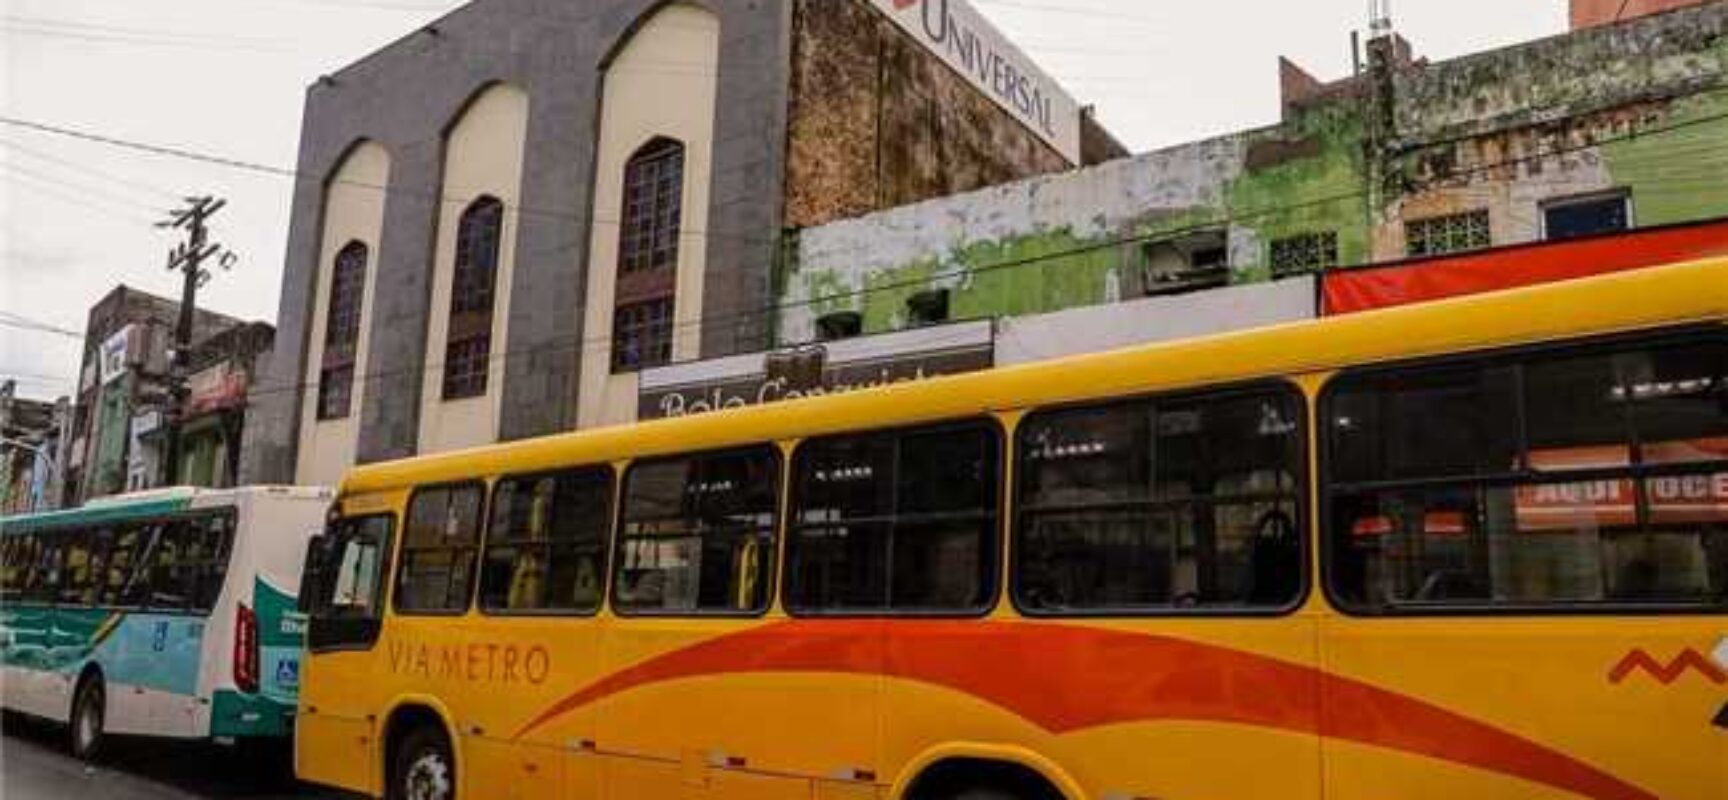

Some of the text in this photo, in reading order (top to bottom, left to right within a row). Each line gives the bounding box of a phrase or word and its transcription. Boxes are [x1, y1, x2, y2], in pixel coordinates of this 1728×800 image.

[921, 0, 1057, 139] UNIVERSAL
[387, 639, 550, 685] VIA METRO
